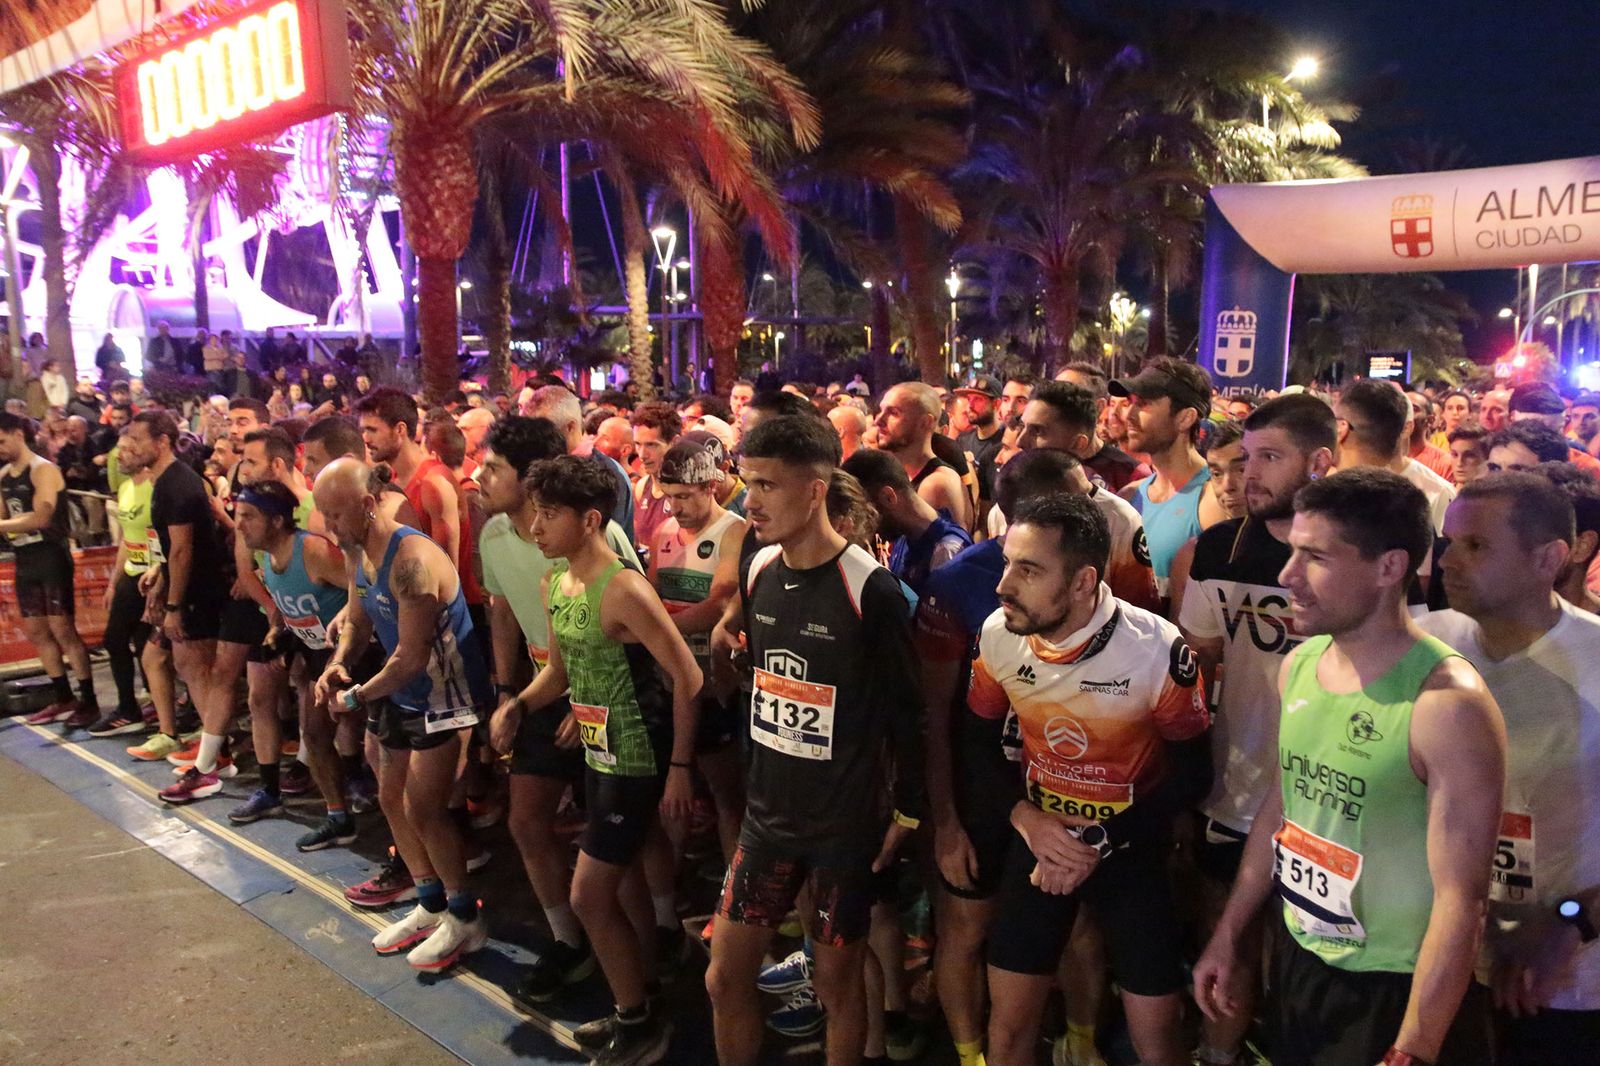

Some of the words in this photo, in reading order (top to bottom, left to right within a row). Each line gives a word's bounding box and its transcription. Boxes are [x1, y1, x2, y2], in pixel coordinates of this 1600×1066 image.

[1475, 180, 1600, 223] ALME
[1475, 223, 1583, 250] CIUDAD
[1079, 684, 1111, 695] SALINAS
[1112, 687, 1129, 696] CAR
[769, 698, 820, 733] 132
[1047, 793, 1115, 820] 2609
[1293, 778, 1362, 821] Running
[1290, 857, 1329, 898] 513
